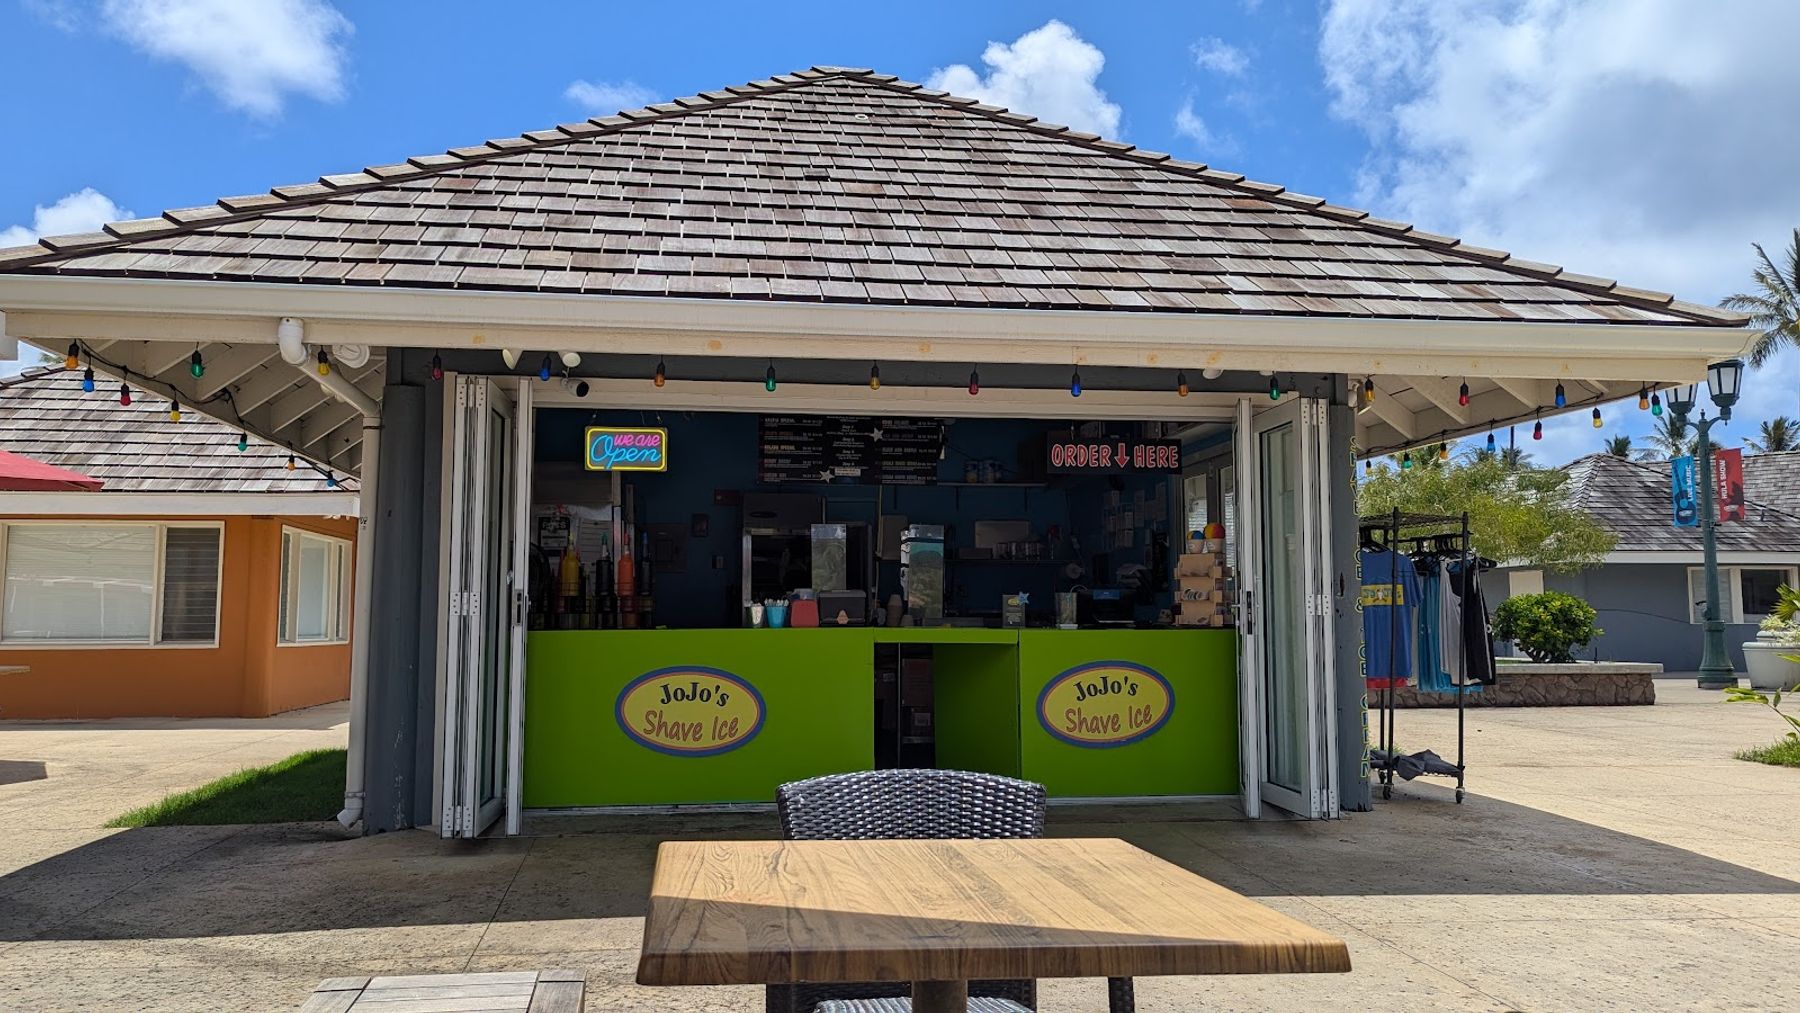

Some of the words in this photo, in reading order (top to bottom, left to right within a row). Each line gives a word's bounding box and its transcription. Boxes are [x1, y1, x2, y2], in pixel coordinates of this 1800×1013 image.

[591, 434, 661, 469] Open
[614, 434, 634, 446] we
[635, 434, 660, 447] are
[1051, 443, 1112, 468] ORDER
[1133, 444, 1179, 469] HERE
[660, 682, 730, 707] JoJo's
[1073, 676, 1138, 702] JoJo's
[643, 710, 703, 742] Shave
[712, 715, 739, 741] Ice
[1065, 707, 1121, 734] Shave
[1128, 704, 1153, 729] Ice
